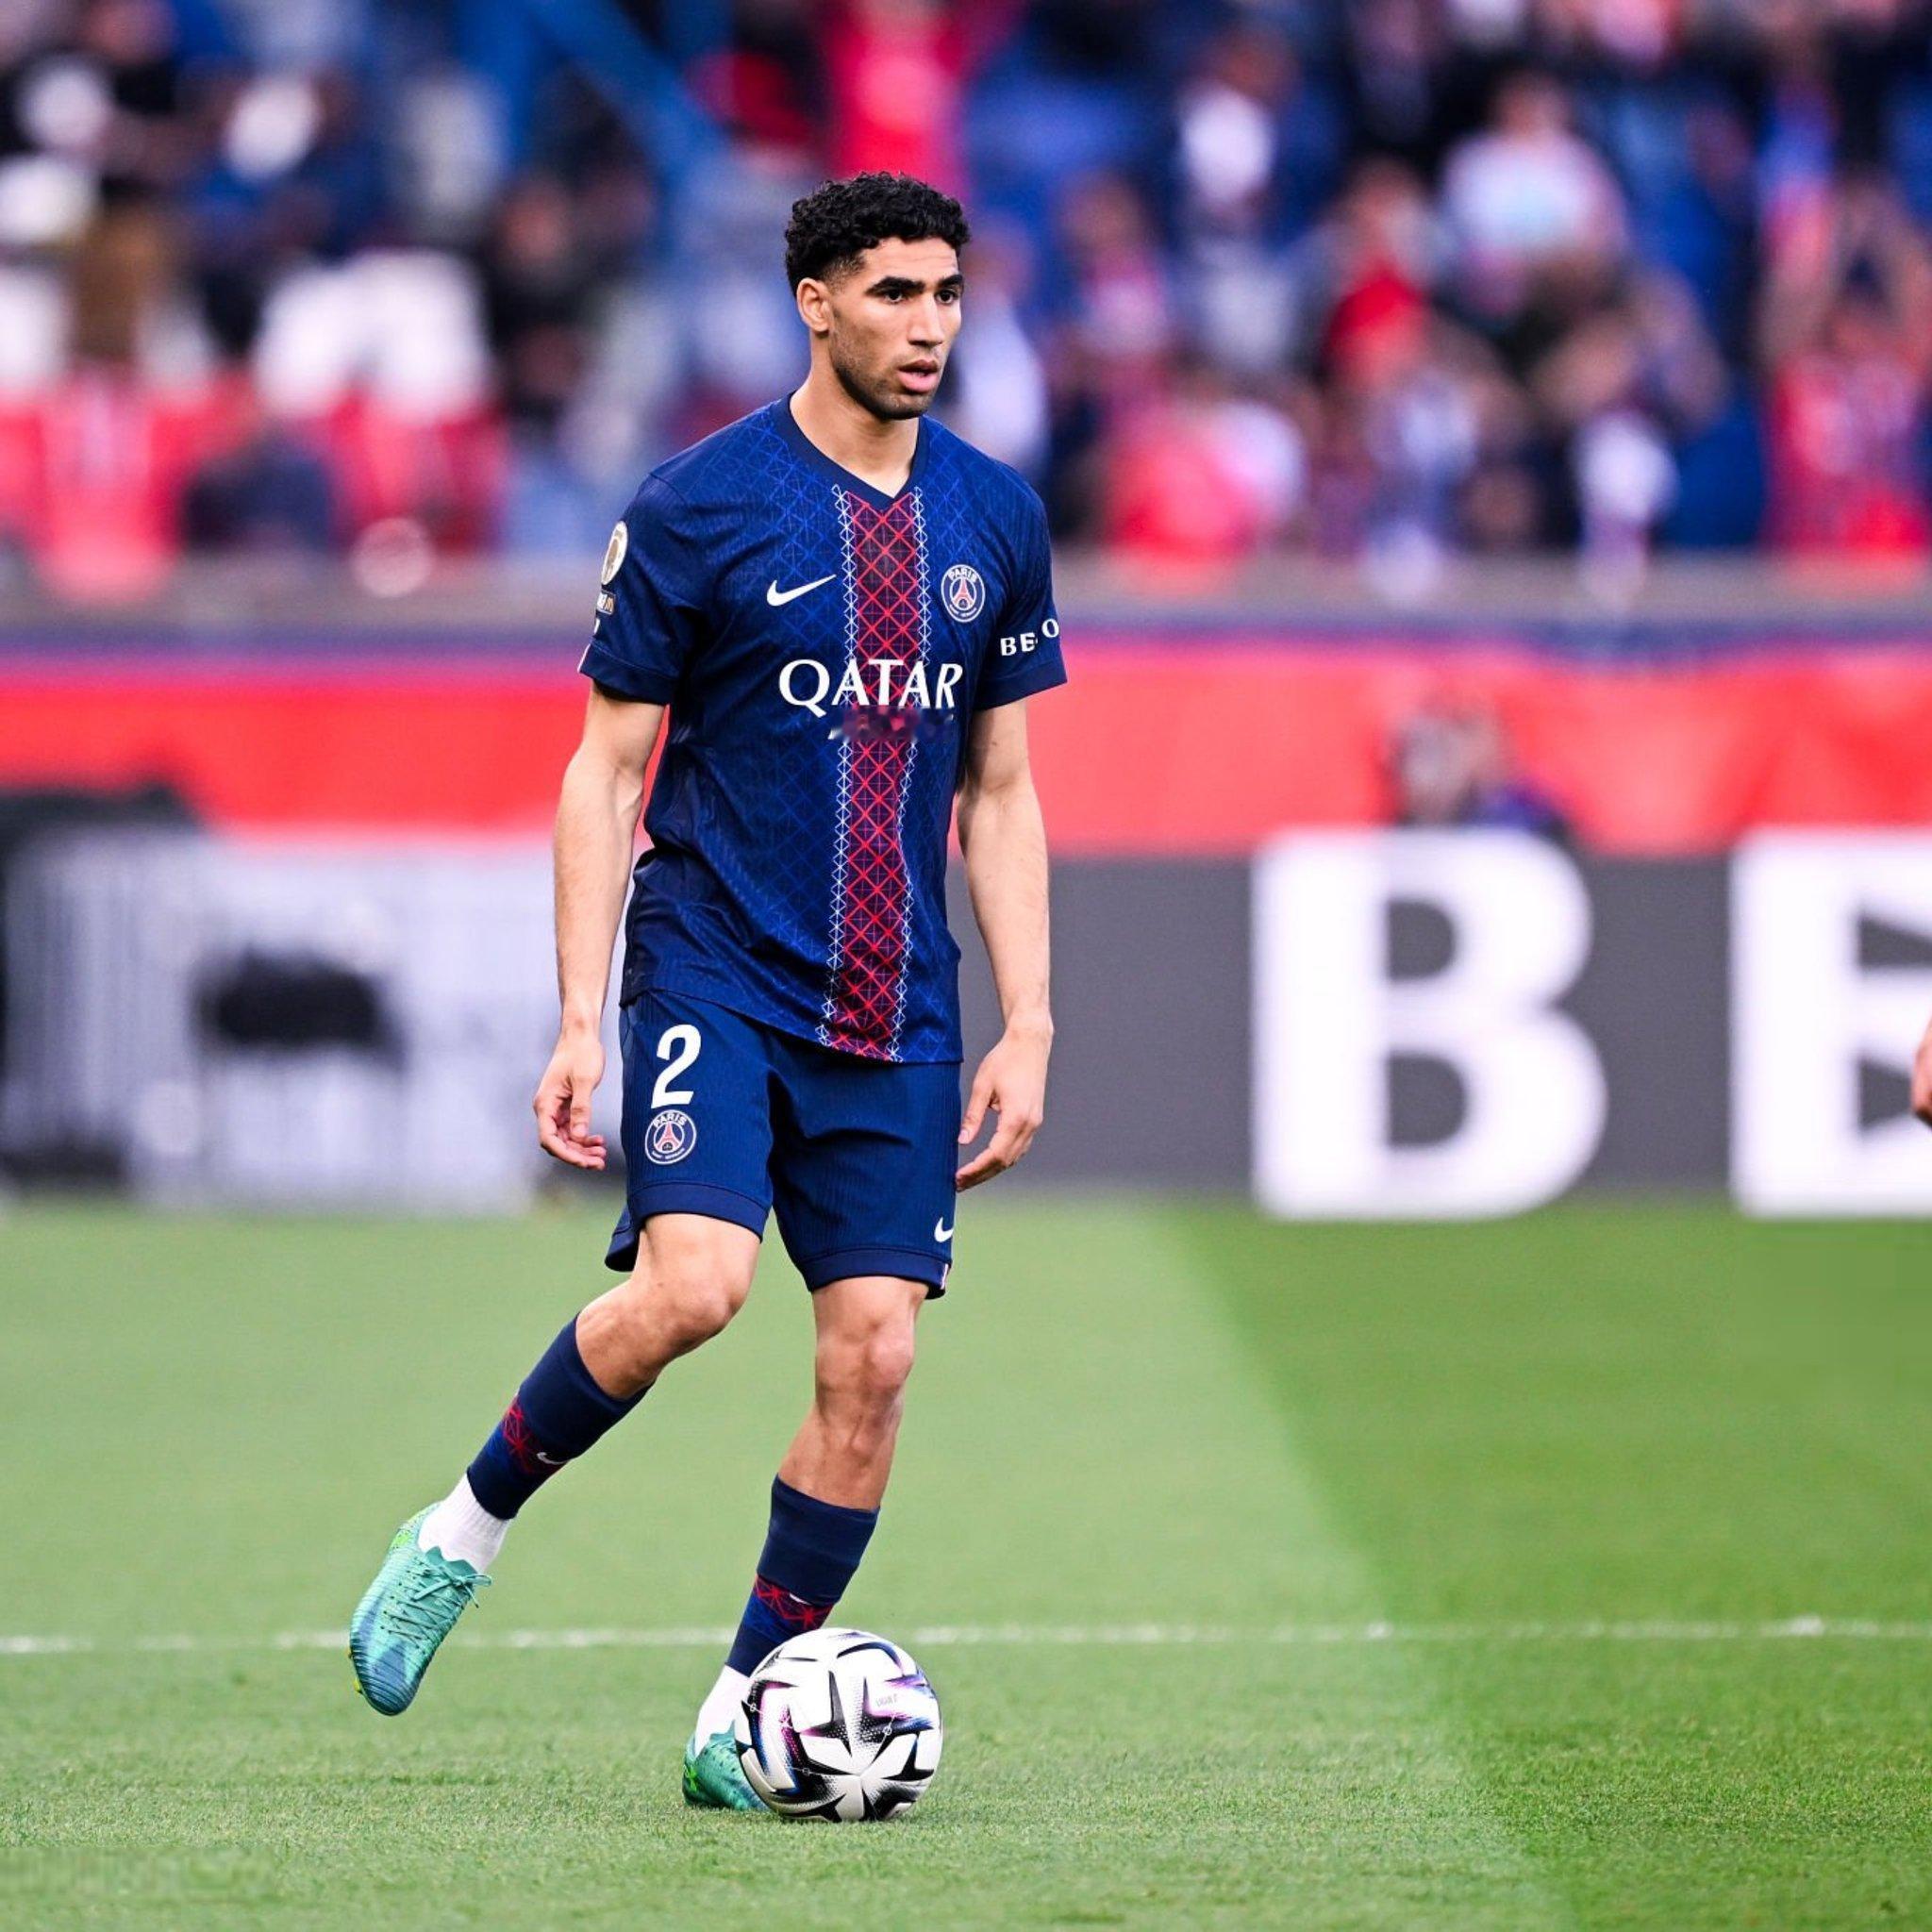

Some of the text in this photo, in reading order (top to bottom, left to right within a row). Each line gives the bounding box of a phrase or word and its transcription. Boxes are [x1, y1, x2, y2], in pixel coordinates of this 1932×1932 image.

[779, 658, 964, 718] QATAR
[651, 1024, 701, 1108] 2
[653, 1112, 687, 1128] PARIS
